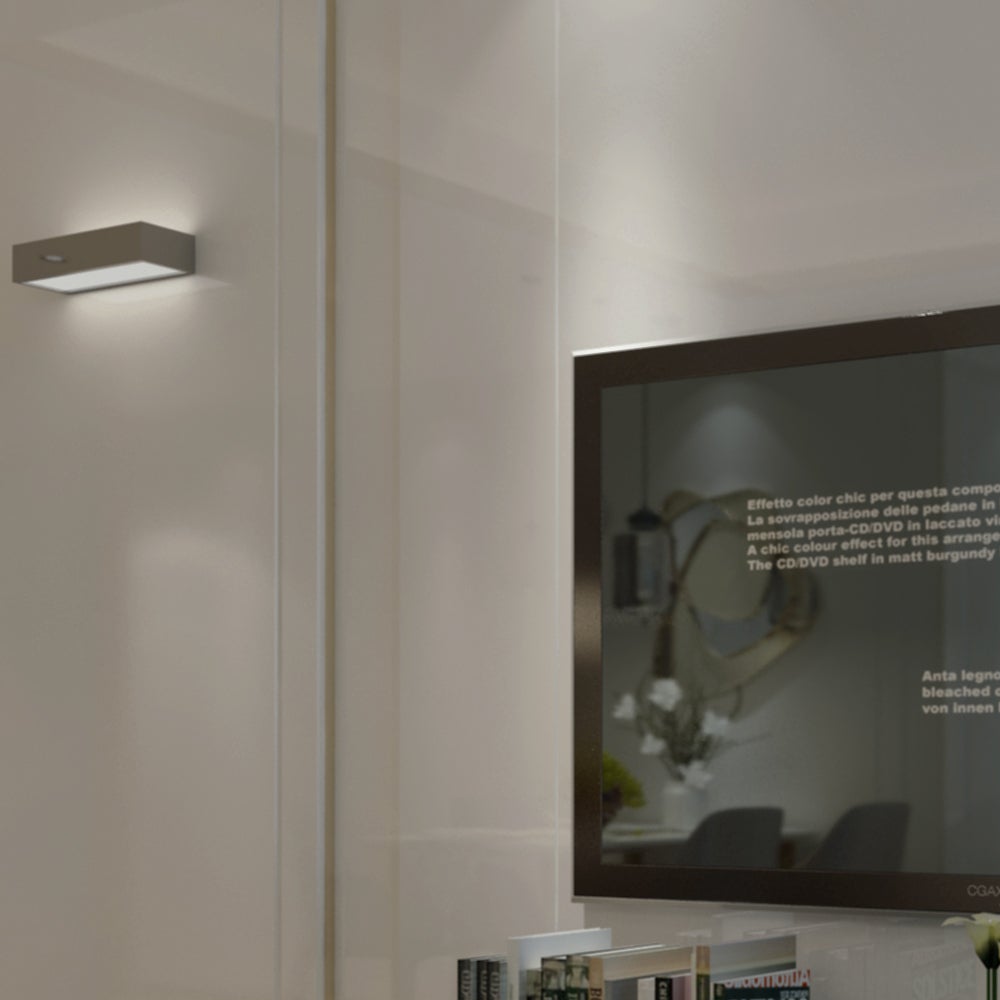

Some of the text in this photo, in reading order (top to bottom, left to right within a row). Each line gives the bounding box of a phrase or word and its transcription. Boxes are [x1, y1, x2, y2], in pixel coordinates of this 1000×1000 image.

[747, 498, 793, 511] Effetto
[797, 494, 833, 507] color
[836, 492, 866, 504] chic
[870, 491, 894, 504] per
[898, 486, 948, 502] questa
[747, 515, 764, 526] La
[768, 508, 880, 525] sovrapposizione
[883, 504, 919, 517] delle
[922, 501, 977, 517] pedane
[982, 499, 995, 510] in
[747, 527, 804, 541] mensola
[907, 520, 921, 531] in
[925, 517, 981, 530] laccato
[747, 544, 757, 556] A
[760, 543, 790, 555] chic
[793, 541, 838, 553] colour
[841, 537, 883, 550] effect
[886, 536, 908, 547] for
[911, 534, 939, 546] this
[747, 560, 773, 571] The
[776, 556, 829, 570] CD/DVD
[833, 553, 868, 567] shelf
[871, 553, 884, 564] in
[888, 551, 923, 563] matt
[926, 547, 996, 563] burgundy
[922, 670, 957, 682] Anta
[922, 685, 991, 698] bleached
[922, 705, 949, 714] von
[953, 702, 994, 713] innen
